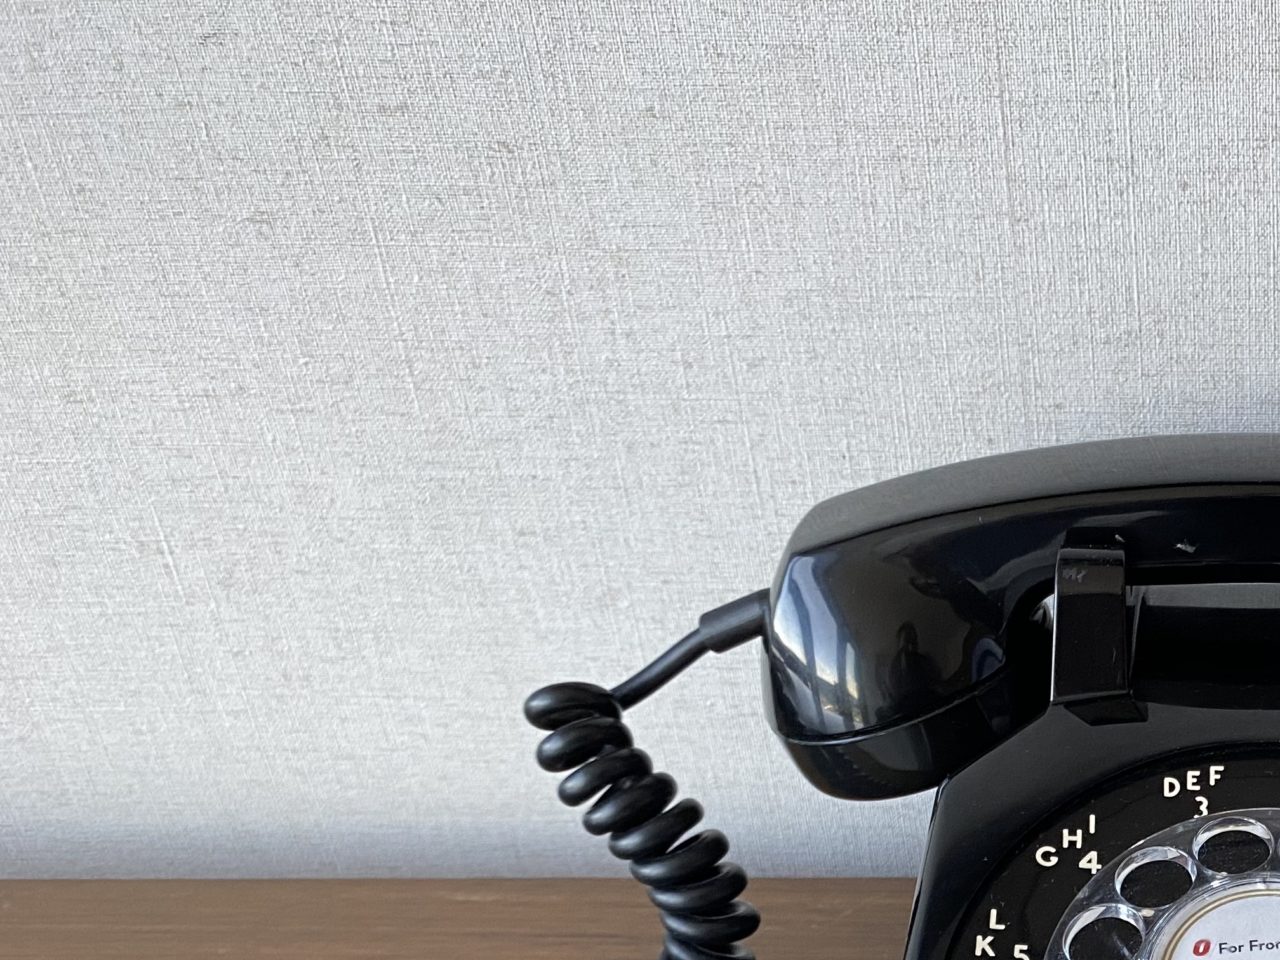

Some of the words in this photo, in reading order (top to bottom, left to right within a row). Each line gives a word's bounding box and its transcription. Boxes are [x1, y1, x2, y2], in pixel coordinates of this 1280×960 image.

[1162, 764, 1226, 799] DEF
[1193, 794, 1210, 819] 3
[1077, 849, 1104, 875] 4
[1192, 938, 1212, 957] 0
[1218, 942, 1245, 955] For
